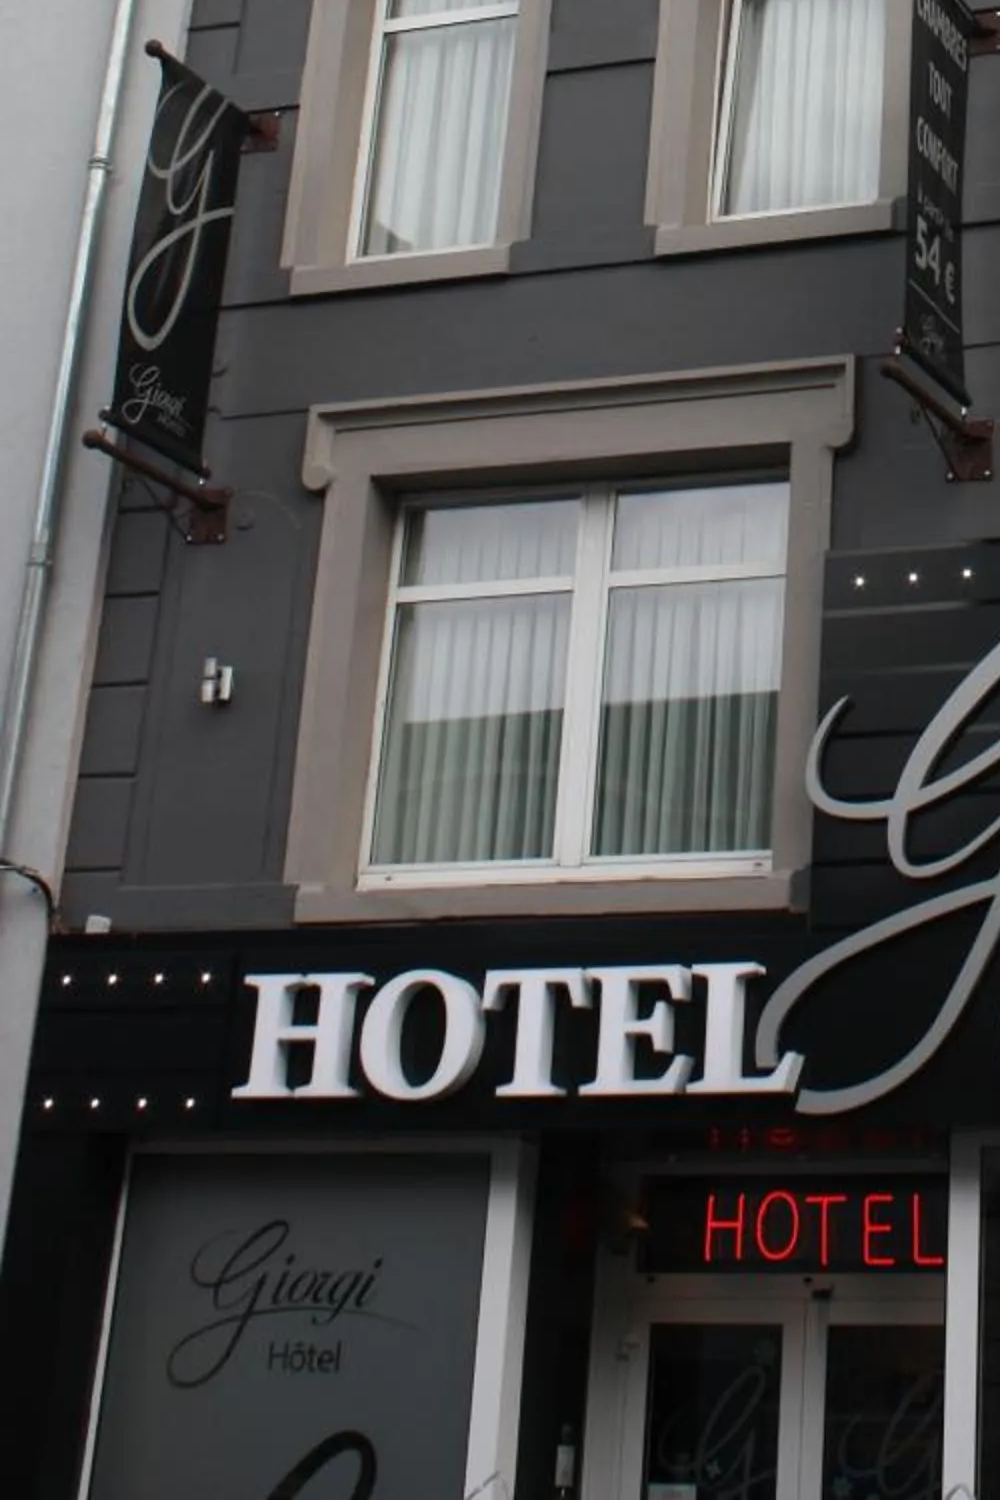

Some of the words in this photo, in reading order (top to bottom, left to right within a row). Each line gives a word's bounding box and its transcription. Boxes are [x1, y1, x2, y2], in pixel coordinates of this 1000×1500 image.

[927, 59, 952, 115] TOUT
[915, 213, 941, 286] 54
[231, 961, 804, 1101] HOTEL
[704, 1190, 946, 1267] HOTEL
[167, 1219, 395, 1388] Giorgi
[267, 1340, 343, 1374] Hôtel
